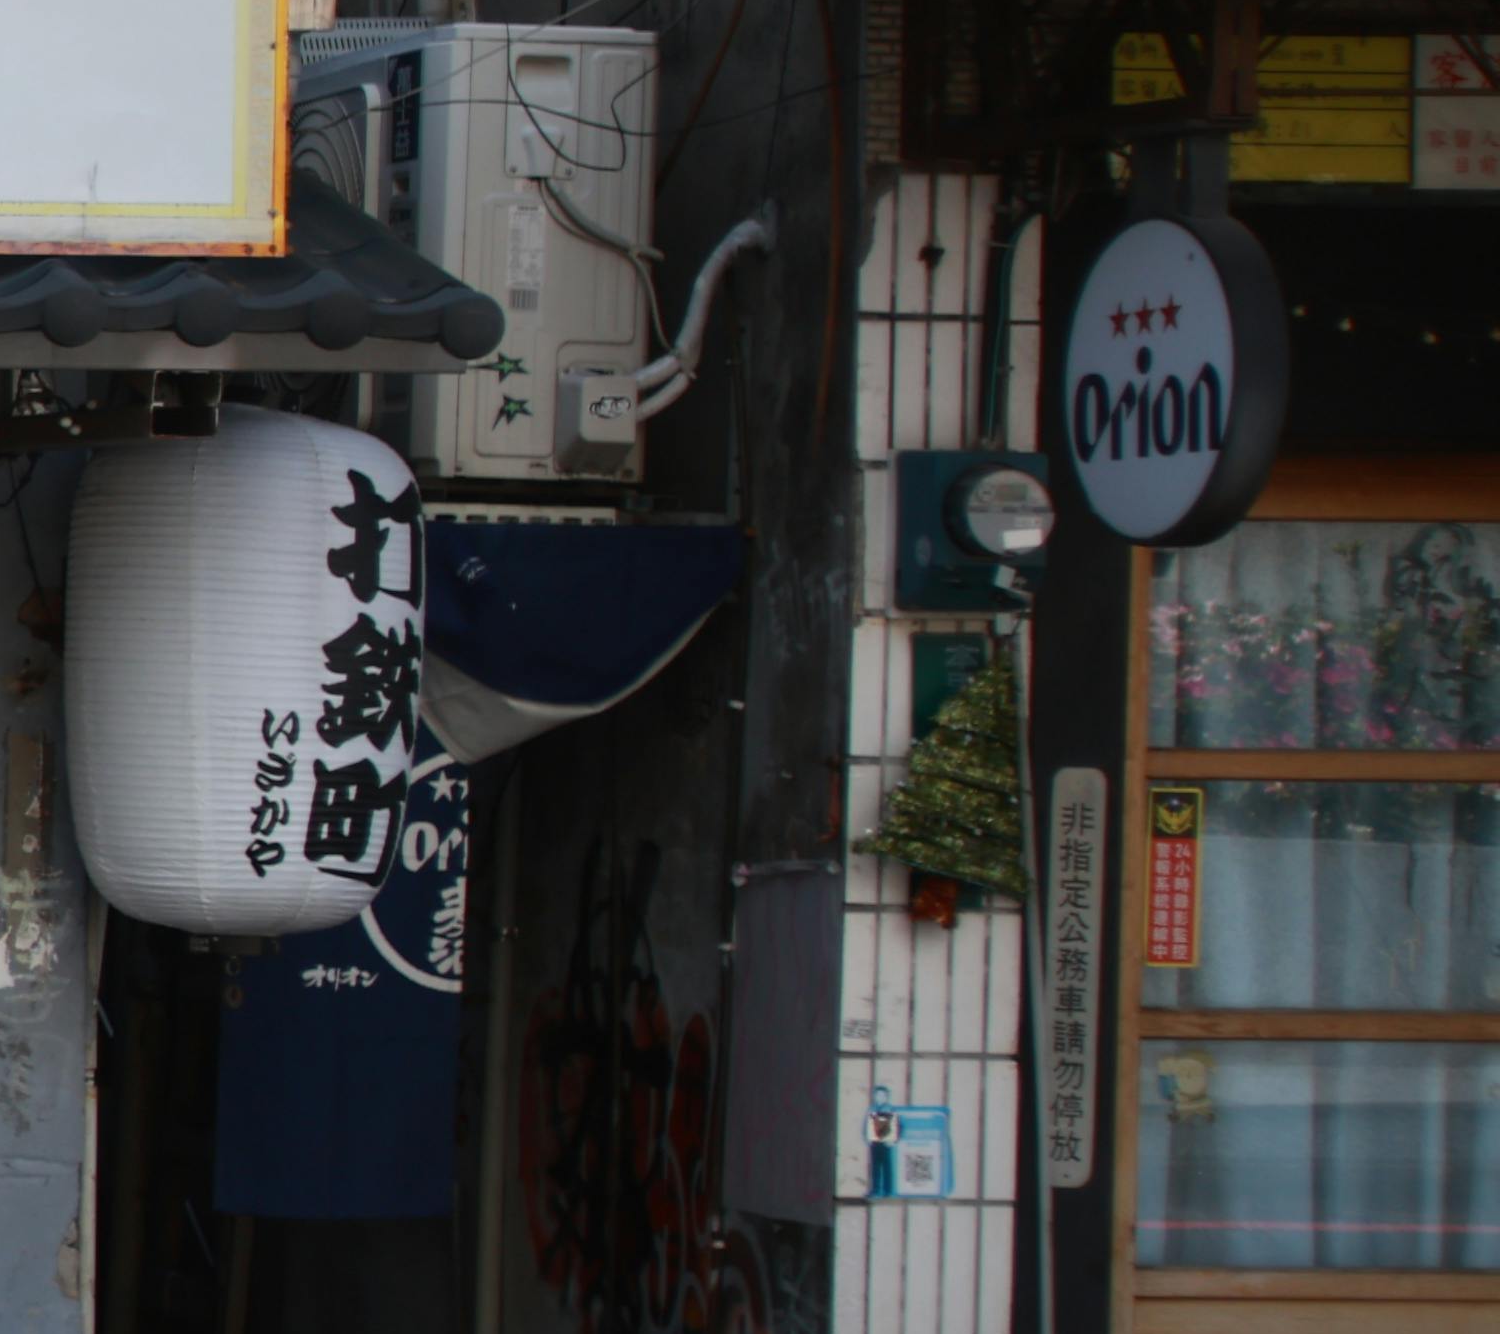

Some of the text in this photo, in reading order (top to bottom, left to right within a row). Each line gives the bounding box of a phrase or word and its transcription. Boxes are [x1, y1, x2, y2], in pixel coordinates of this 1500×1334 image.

[1073, 345, 1224, 463] Orion
[246, 708, 300, 878] いざかや
[299, 963, 380, 992] オリオン
[1049, 801, 1095, 1164] 非指定公務車請勿停放
